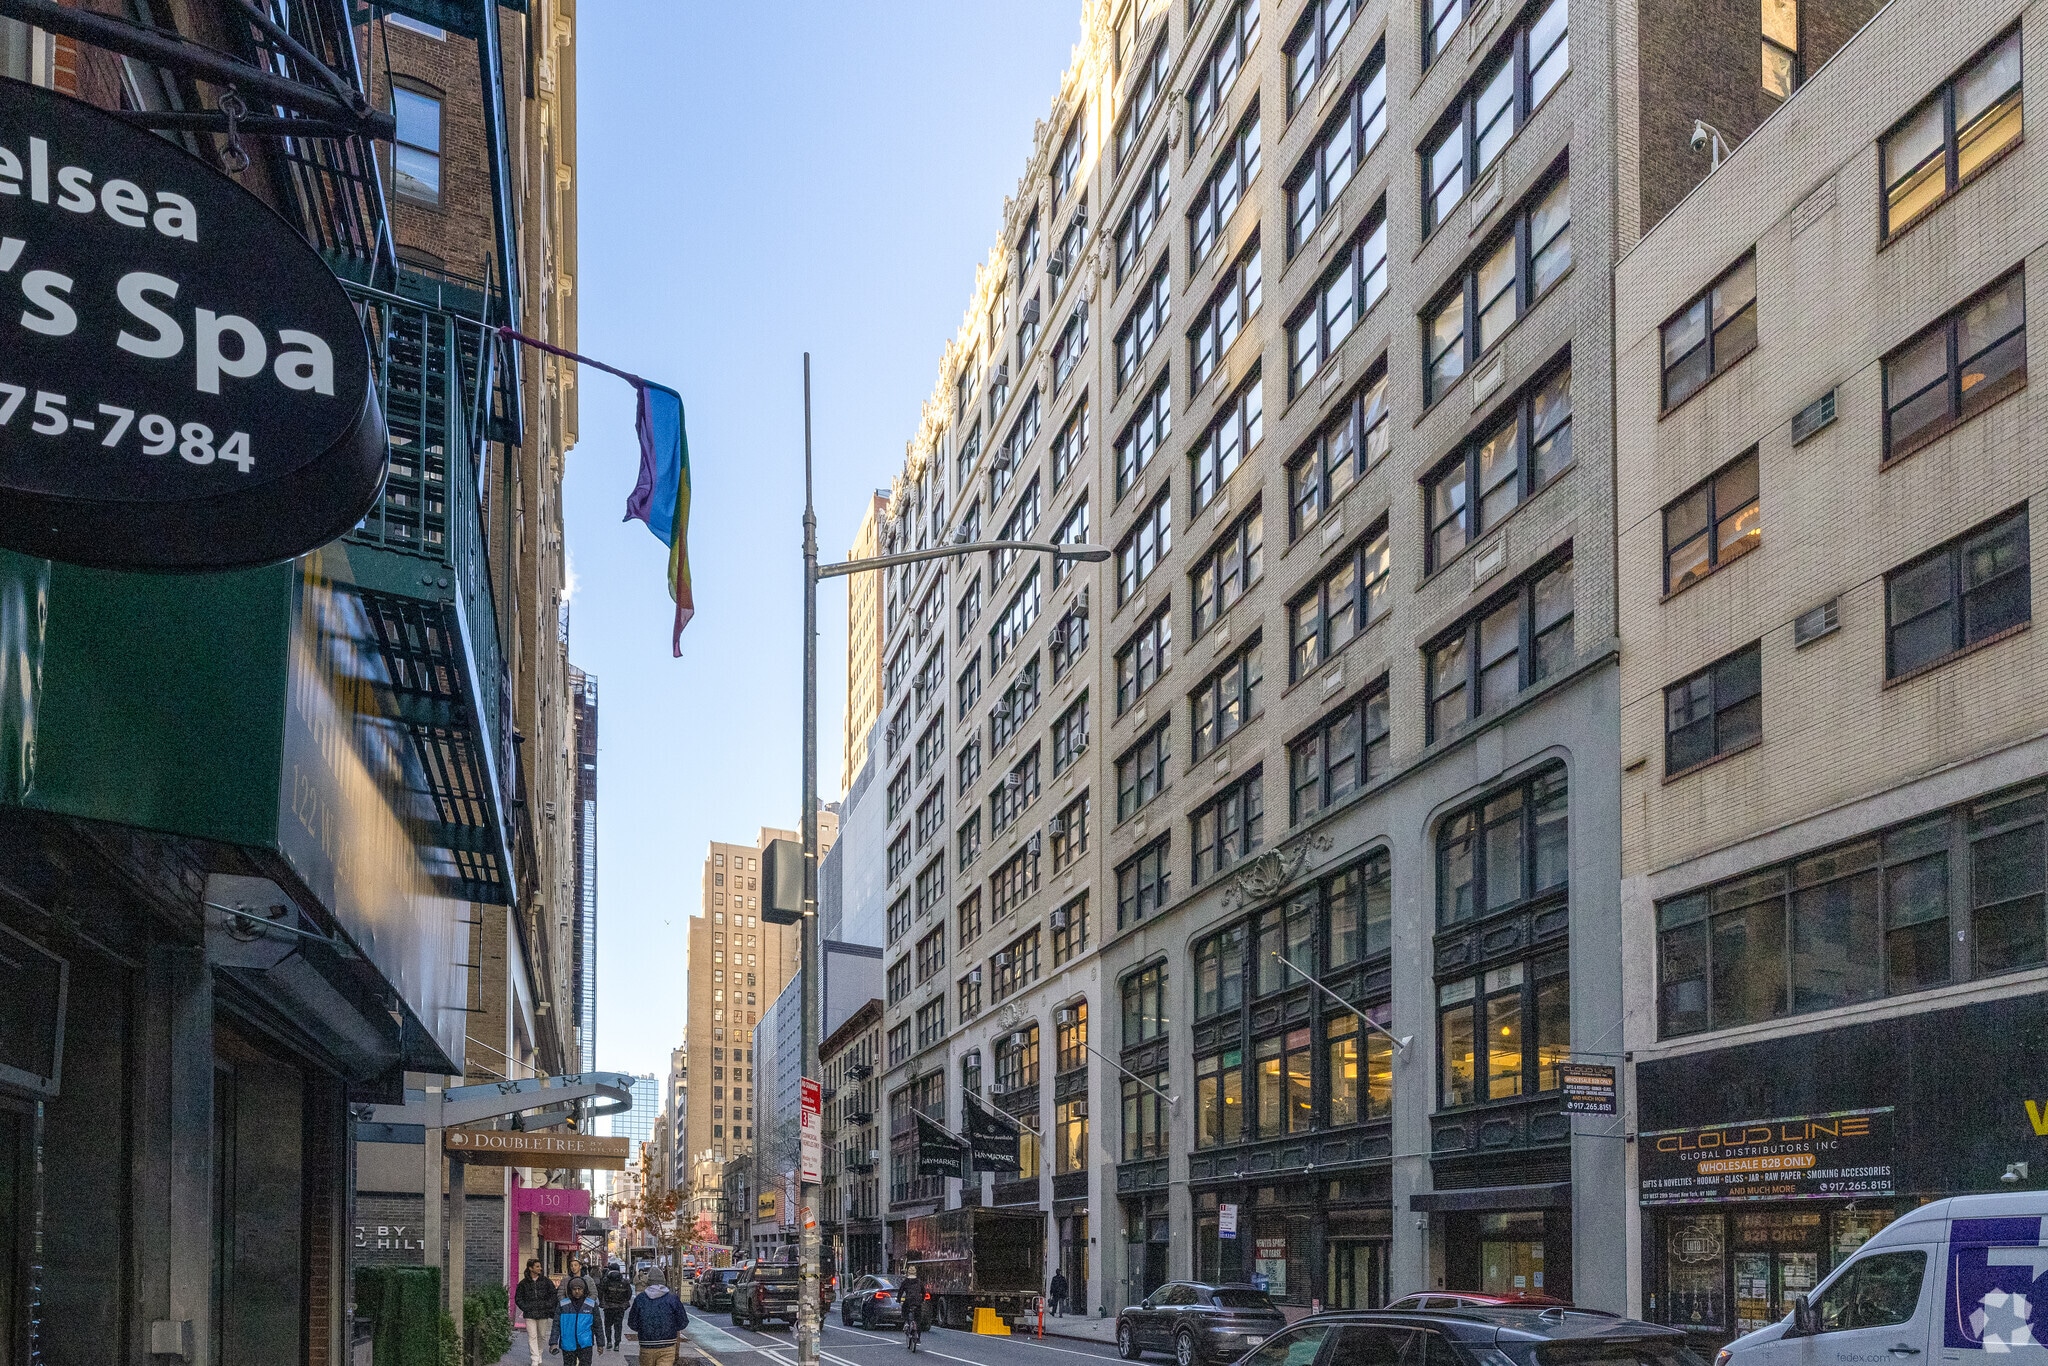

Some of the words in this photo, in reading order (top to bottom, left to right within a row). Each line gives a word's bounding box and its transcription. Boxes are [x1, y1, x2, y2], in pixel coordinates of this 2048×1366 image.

[116, 271, 335, 396] Spa
[291, 764, 316, 838] 122
[1574, 1102, 1612, 1110] 917.265.8151
[802, 1111, 808, 1126] 3
[1656, 1128, 1772, 1152] CLOUD
[1782, 1118, 1870, 1142] LINE
[1680, 1151, 1720, 1161] GLOBAL
[1726, 1144, 1810, 1157] DISTRIBUTORS
[1816, 1141, 1838, 1150] INC
[922, 1157, 960, 1168] HAYMARKET
[1700, 1160, 1758, 1173] WHOLESALE
[1761, 1158, 1781, 1169] B2B
[1784, 1156, 1813, 1167] ONLY
[1642, 1180, 1657, 1189] GIFTS
[1658, 1179, 1663, 1187] &
[1664, 1177, 1692, 1187] NOVELTIES
[1697, 1175, 1720, 1185] HOOKAH
[1724, 1174, 1744, 1183] GLASS
[1748, 1173, 1760, 1182] JAR
[1764, 1172, 1778, 1181] RAW
[1781, 1171, 1801, 1180] PAPER
[1807, 1168, 1839, 1179] SMOKING
[1841, 1165, 1891, 1177] ACCESSORIES
[1729, 1187, 1745, 1195] AND
[1747, 1186, 1770, 1194] MUCH
[1772, 1184, 1796, 1193] MORE
[1829, 1180, 1891, 1191] 917.265.8151
[540, 1195, 560, 1206] 130
[377, 1226, 406, 1236] BY
[1837, 1352, 1892, 1364] fedex.com
